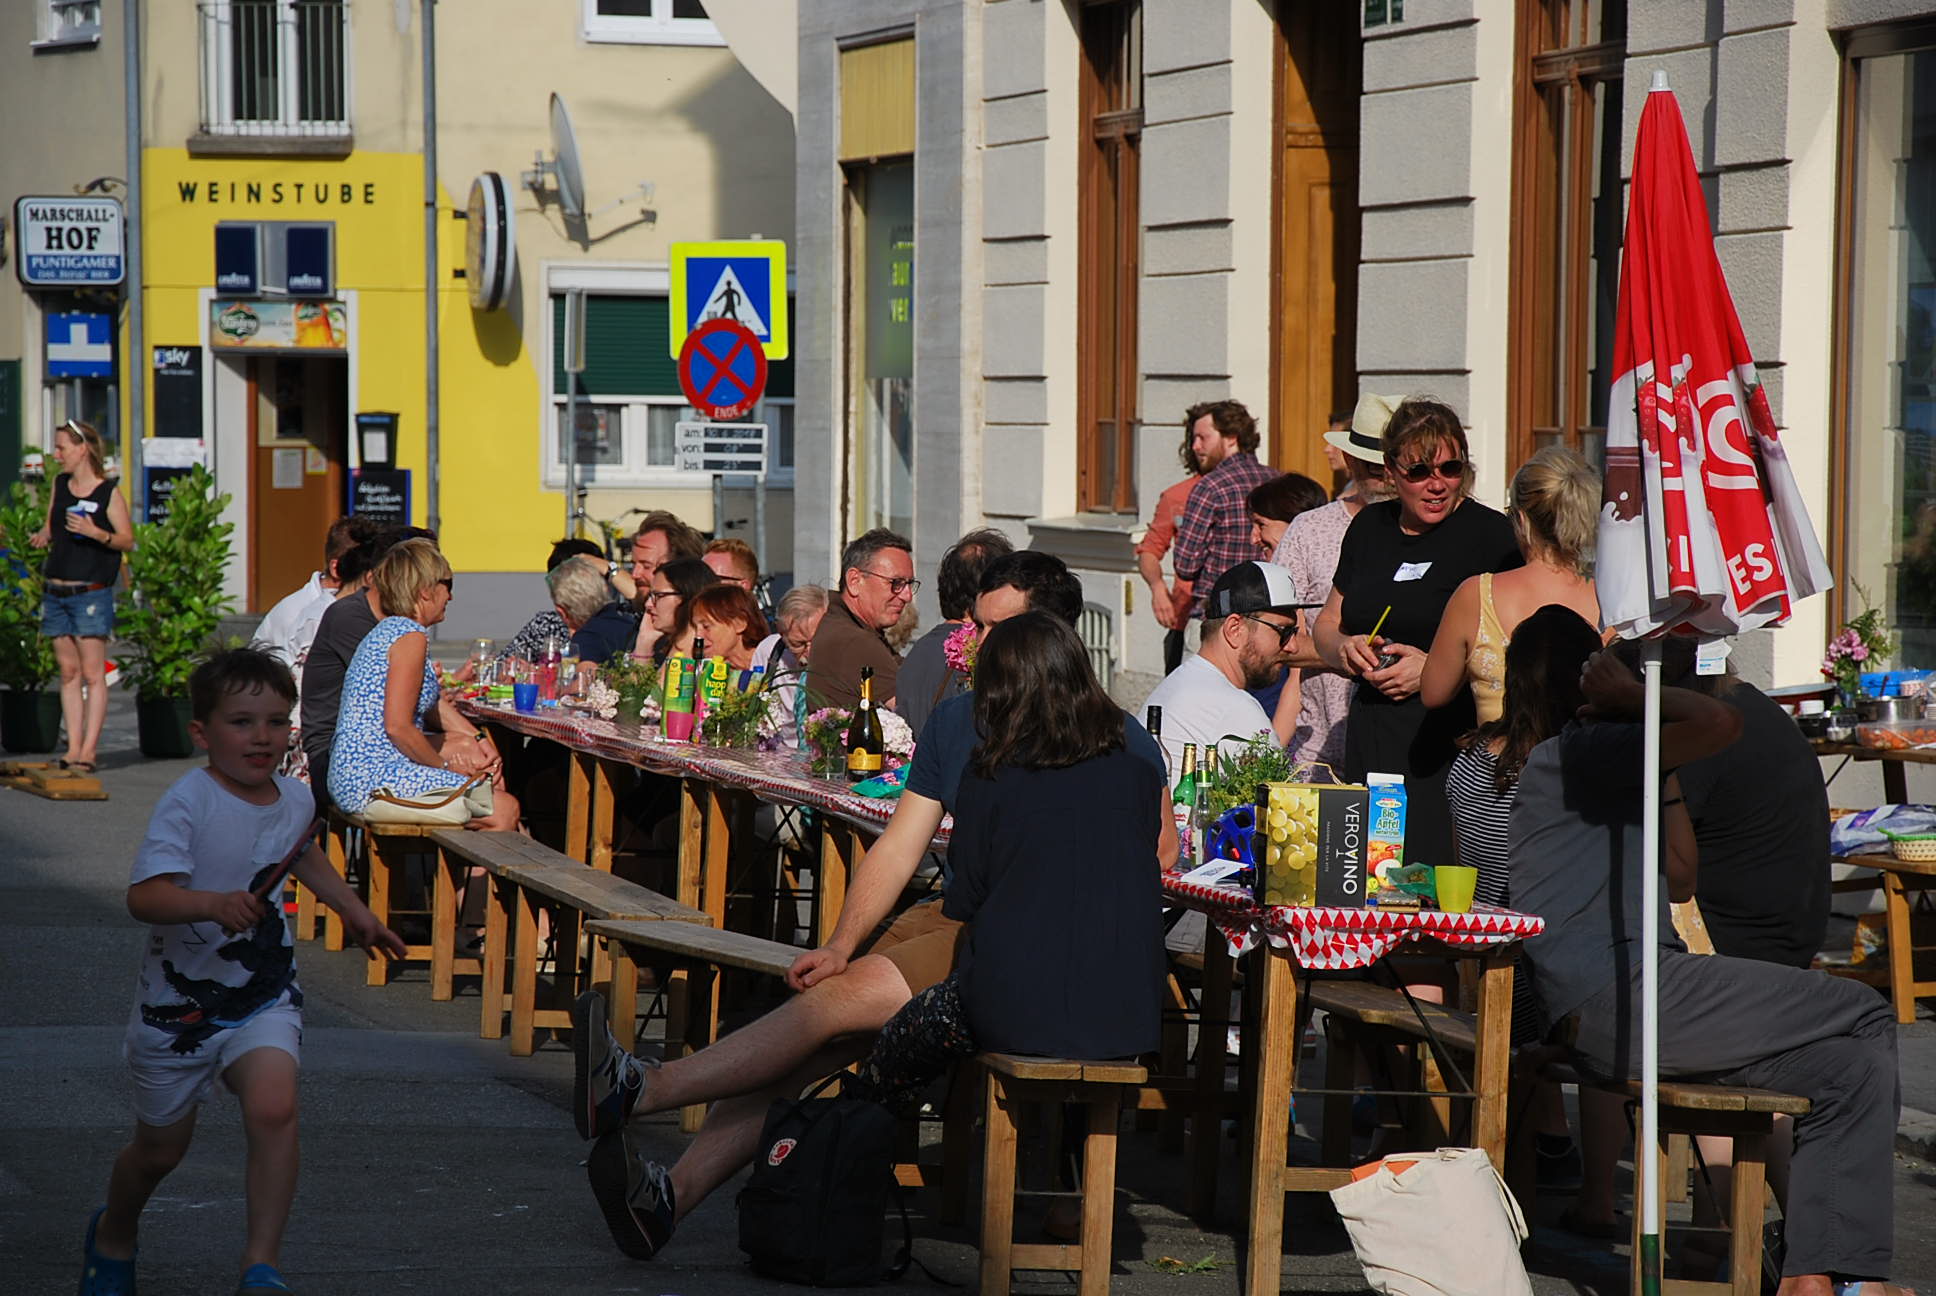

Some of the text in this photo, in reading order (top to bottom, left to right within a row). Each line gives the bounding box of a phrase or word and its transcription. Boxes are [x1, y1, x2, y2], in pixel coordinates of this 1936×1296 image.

[178, 182, 375, 204] WEINSTUBE
[29, 208, 115, 222] MARSCHALL-
[45, 226, 101, 250] HOF
[31, 256, 117, 269] PUNTIGAMER
[164, 348, 191, 367] sky
[714, 405, 739, 418] ENDE
[1336, 802, 1361, 895] VEROVINO
